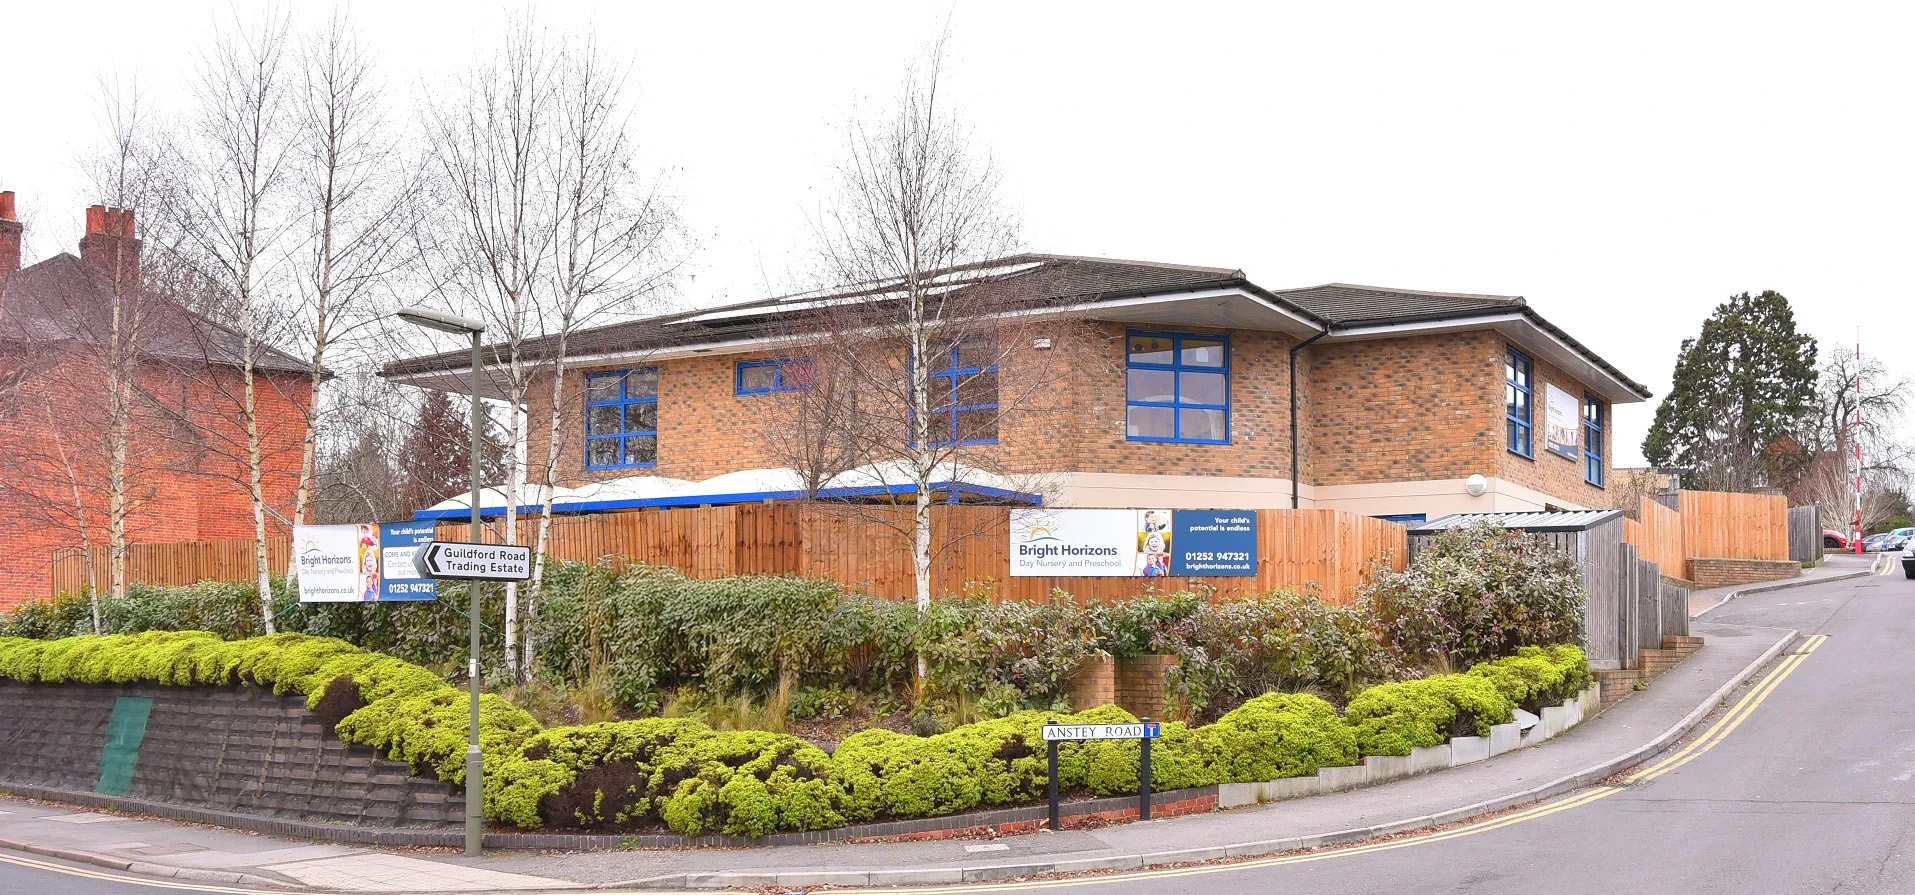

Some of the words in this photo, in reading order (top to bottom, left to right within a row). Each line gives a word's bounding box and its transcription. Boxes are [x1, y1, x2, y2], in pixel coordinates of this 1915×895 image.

[390, 528, 400, 536] Your
[400, 527, 414, 535] child's
[415, 526, 434, 536] potential
[444, 547, 495, 560] Guildford
[499, 550, 526, 561] Road
[1019, 544, 1058, 559] Bright
[1061, 544, 1118, 556] Horizons
[1185, 552, 1214, 560] 01252
[1216, 552, 1249, 560] 947321
[301, 554, 322, 568] Bright
[322, 554, 352, 565] Horizons
[1019, 559, 1034, 568] Day
[1036, 559, 1067, 568] Nursery
[1068, 559, 1083, 567] and
[1084, 559, 1122, 567] Preschool
[1186, 562, 1250, 571] brighthorizons.co.uk
[446, 561, 486, 573] Trading
[490, 563, 524, 573] Estate
[304, 586, 355, 597] brighthorizons.co.uk
[388, 583, 409, 594] 01252
[410, 583, 434, 593] 947321
[1047, 726, 1097, 738] ANSTEY
[1105, 725, 1142, 737] ROAD
